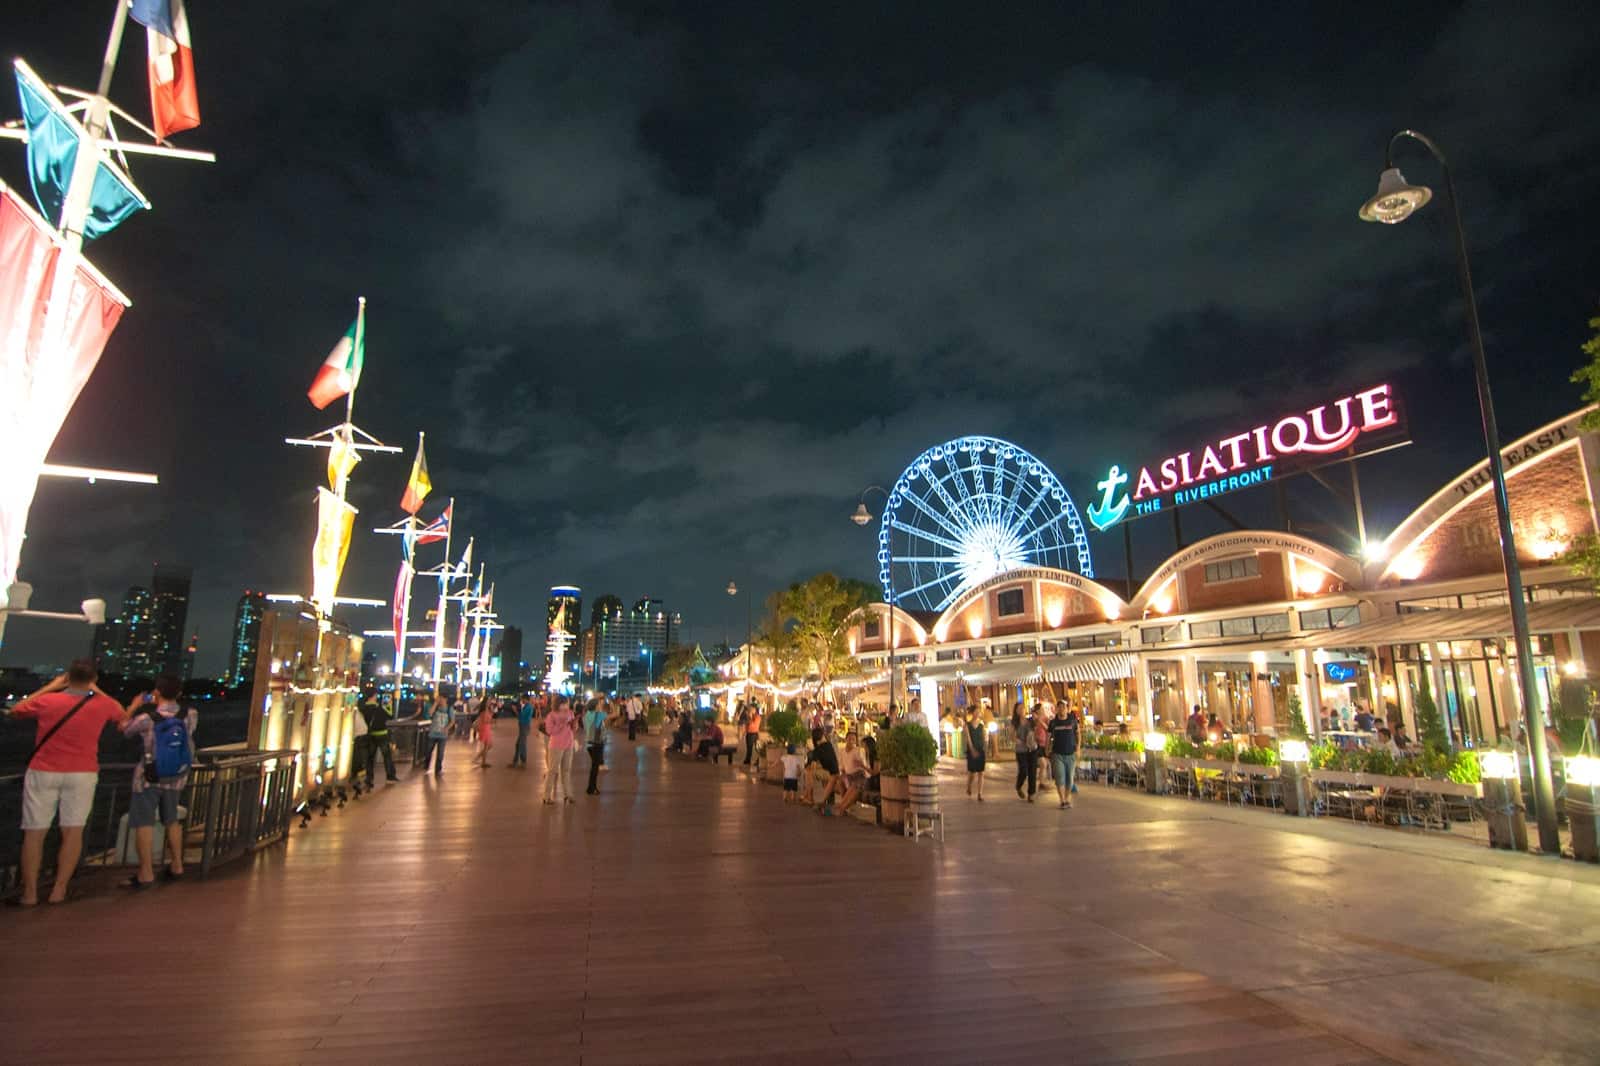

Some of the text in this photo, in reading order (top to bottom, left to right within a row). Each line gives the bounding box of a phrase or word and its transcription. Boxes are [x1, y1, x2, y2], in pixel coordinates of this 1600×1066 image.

[1133, 384, 1397, 499] ASIATIQUE
[1507, 425, 1568, 466] EAST
[1136, 466, 1273, 515] THE RIVERFRONT
[1194, 541, 1226, 556] ASIATIC
[1226, 536, 1272, 546] COMPANY
[1276, 540, 1315, 555] LIMITED
[1006, 568, 1042, 580] COMPANY
[1045, 570, 1082, 587] LIMITED
